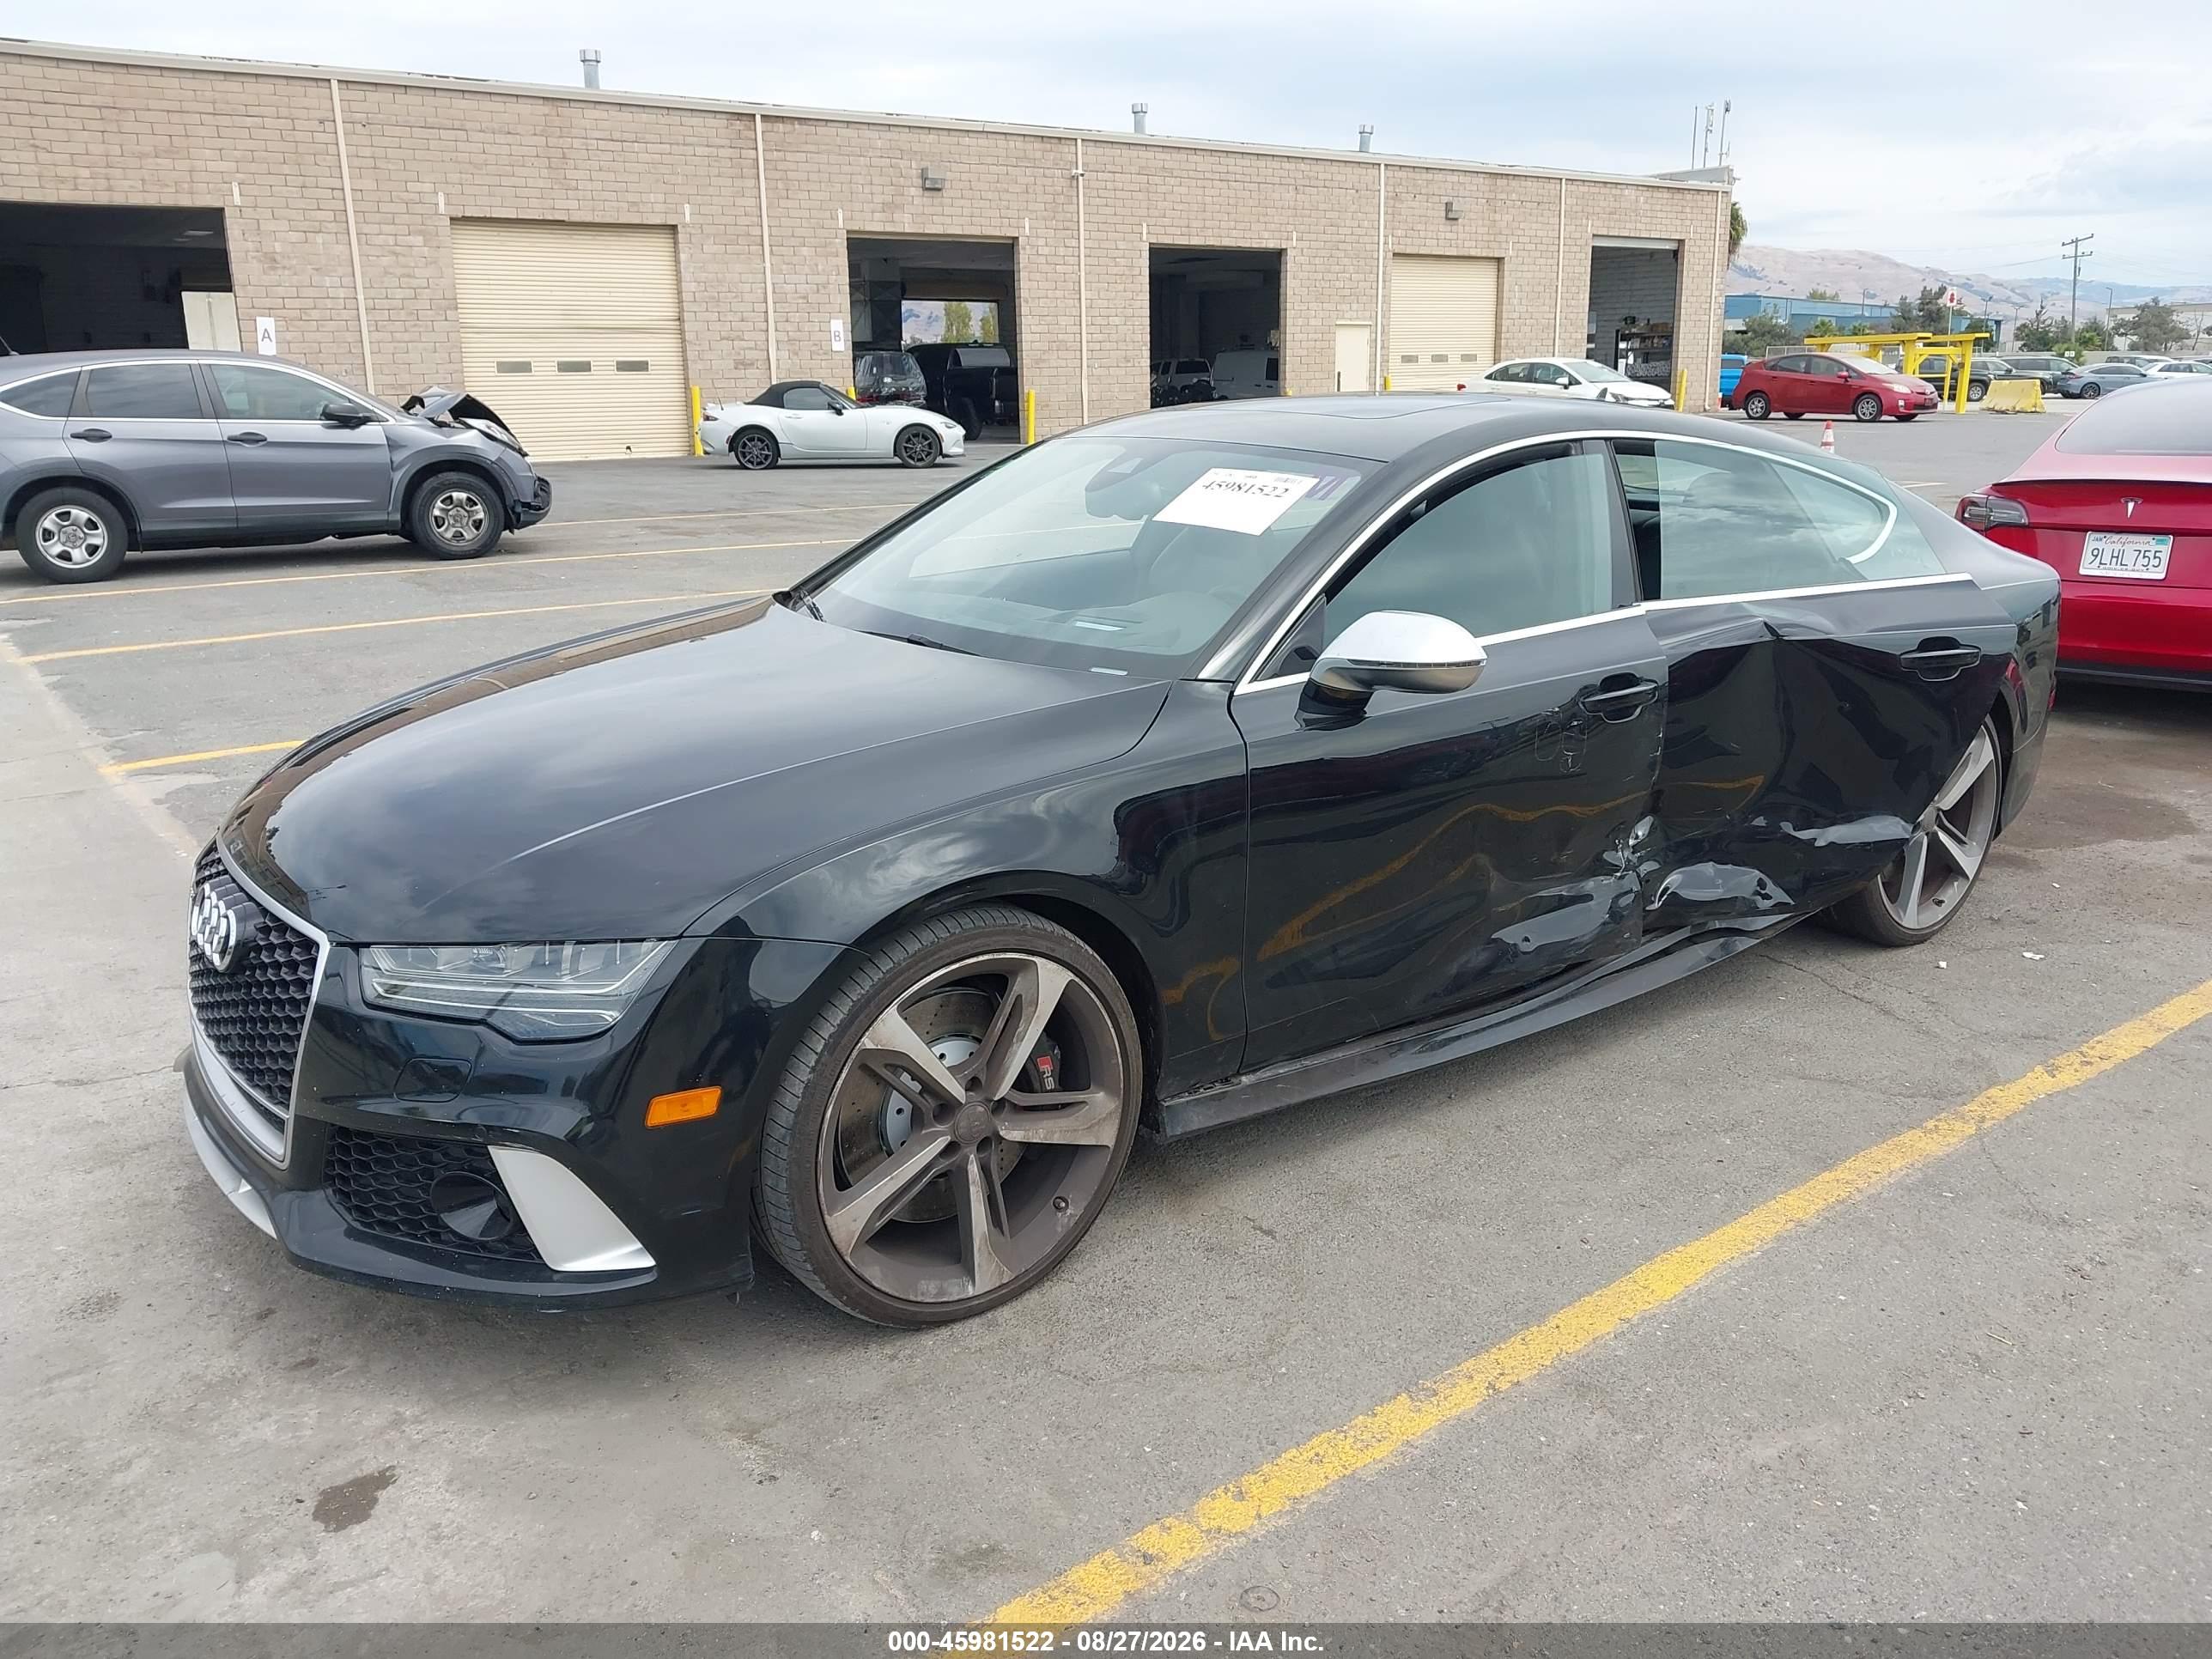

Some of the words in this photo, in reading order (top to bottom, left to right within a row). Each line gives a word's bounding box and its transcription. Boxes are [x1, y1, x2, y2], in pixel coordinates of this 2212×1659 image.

[261, 328, 273, 343] A
[834, 331, 842, 342] B
[1202, 480, 1290, 498] 45981522
[2105, 535, 2151, 548] California
[1042, 1065, 1055, 1091] RS
